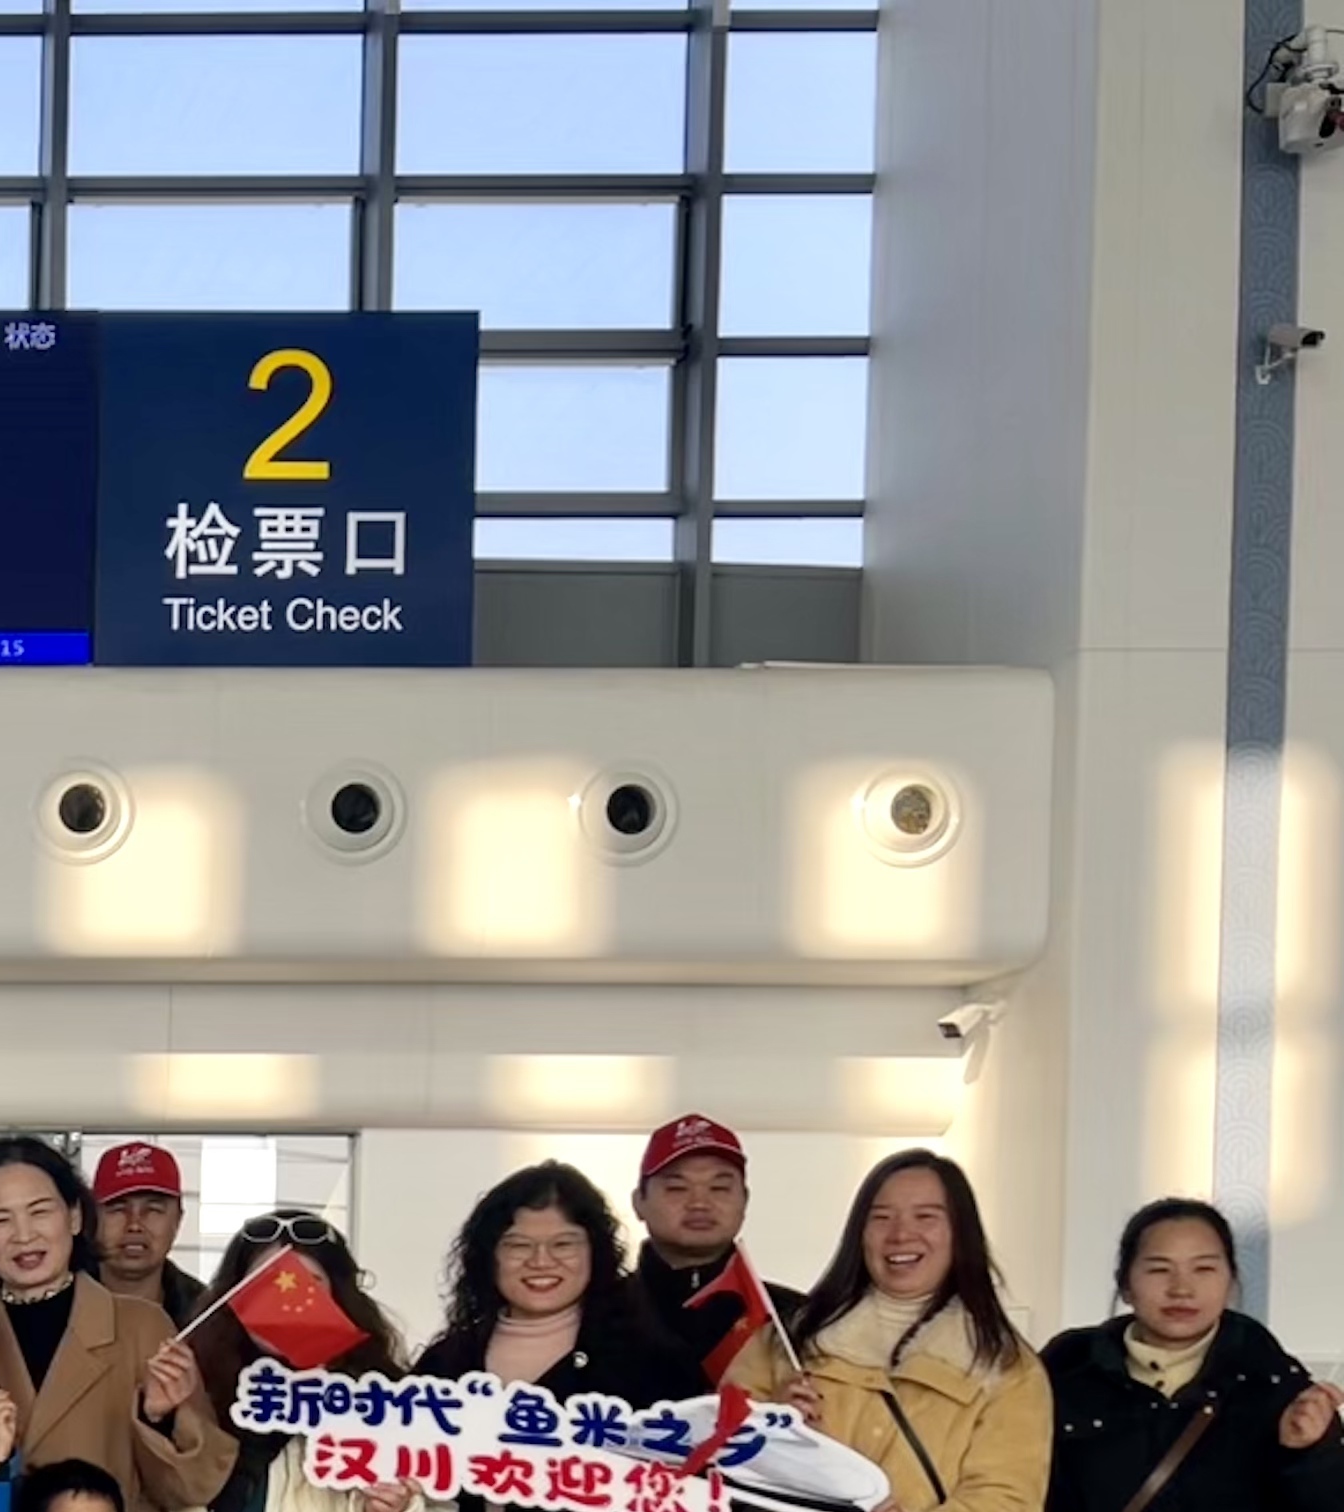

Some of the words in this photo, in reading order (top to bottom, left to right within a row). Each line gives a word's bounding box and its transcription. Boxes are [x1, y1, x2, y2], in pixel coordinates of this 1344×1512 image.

[4, 323, 55, 350] 状态
[243, 348, 332, 480] 2
[165, 503, 405, 579] 检票口
[163, 598, 272, 630] Ticket
[286, 598, 402, 631] Check
